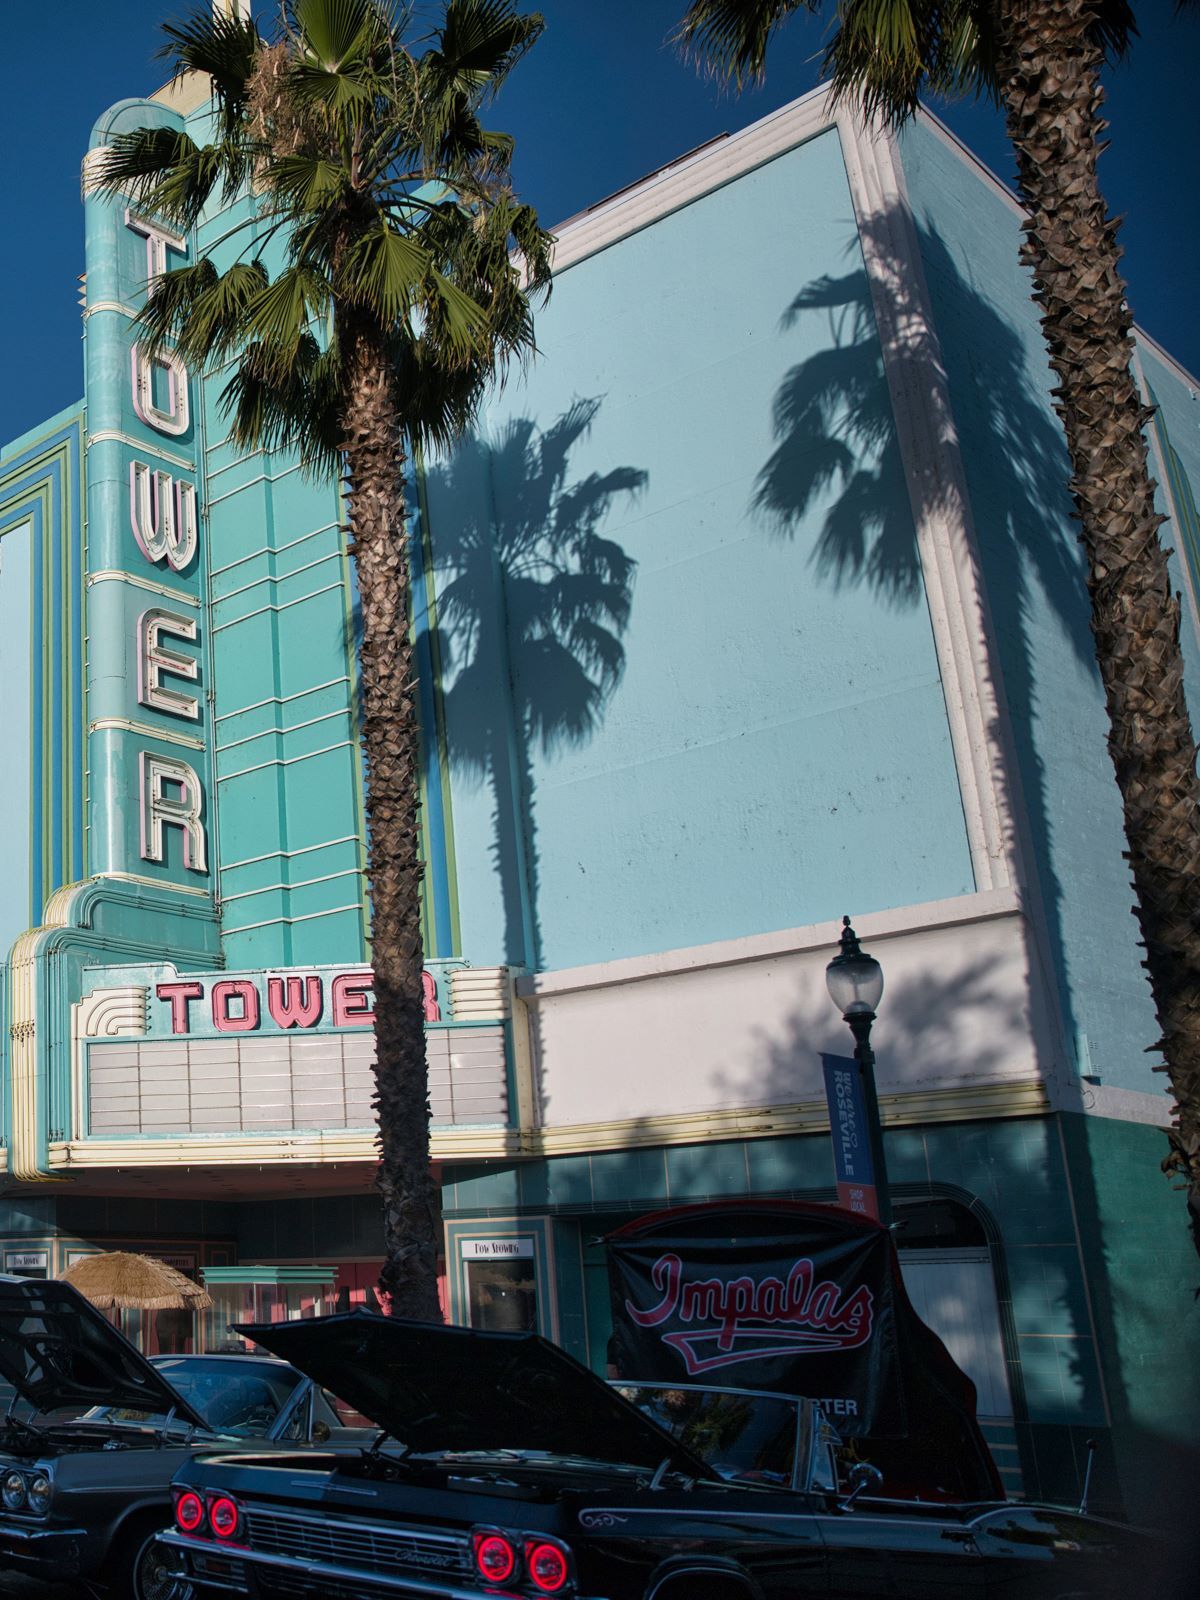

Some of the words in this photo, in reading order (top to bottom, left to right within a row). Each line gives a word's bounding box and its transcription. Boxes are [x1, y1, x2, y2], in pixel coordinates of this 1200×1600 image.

[124, 206, 208, 873] TOWER
[833, 1070, 855, 1176] ROSEVILLE
[845, 1098, 856, 1132] are
[850, 1189, 864, 1200] SHOP
[850, 1201, 866, 1212] LOCAL
[625, 1253, 875, 1351] Impalas
